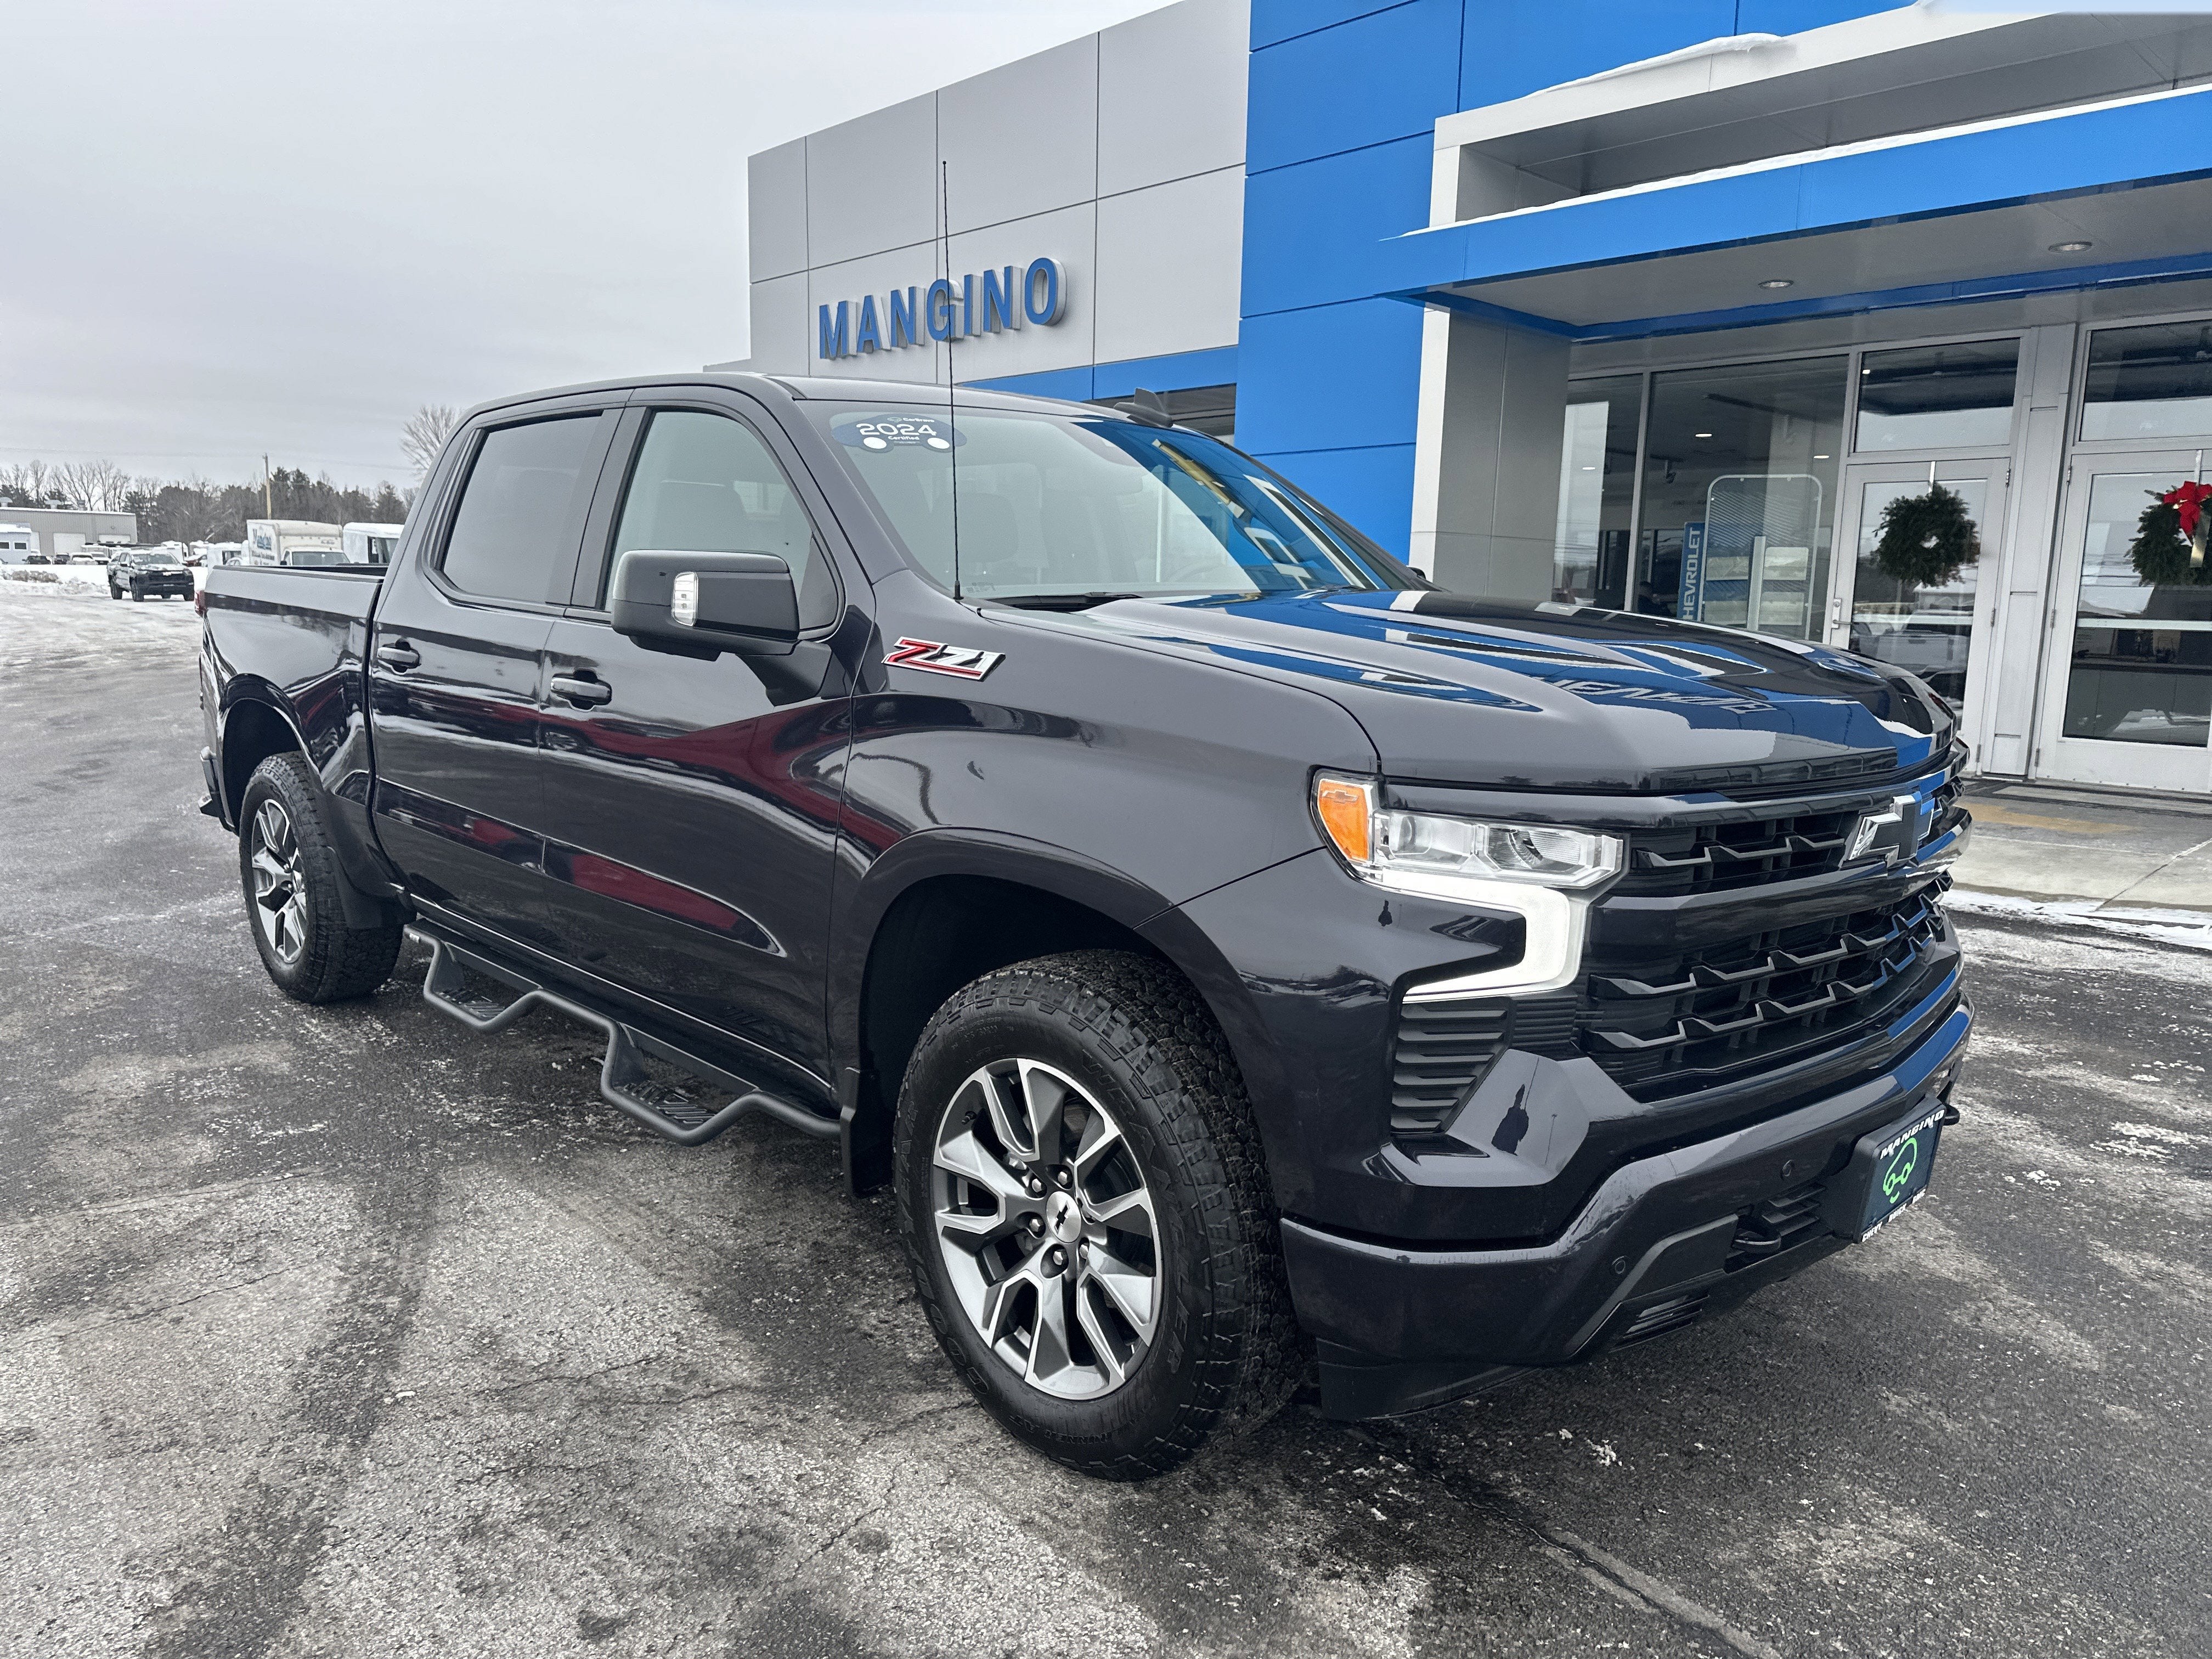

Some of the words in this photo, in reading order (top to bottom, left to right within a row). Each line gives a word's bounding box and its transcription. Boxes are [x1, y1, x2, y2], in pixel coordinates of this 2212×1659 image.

[820, 257, 1065, 360] MANGINO
[856, 423, 937, 436] 2024
[1683, 527, 1701, 620] HEVROLET
[881, 636, 1006, 682] Z71
[1880, 1109, 1945, 1160] MANGINO
